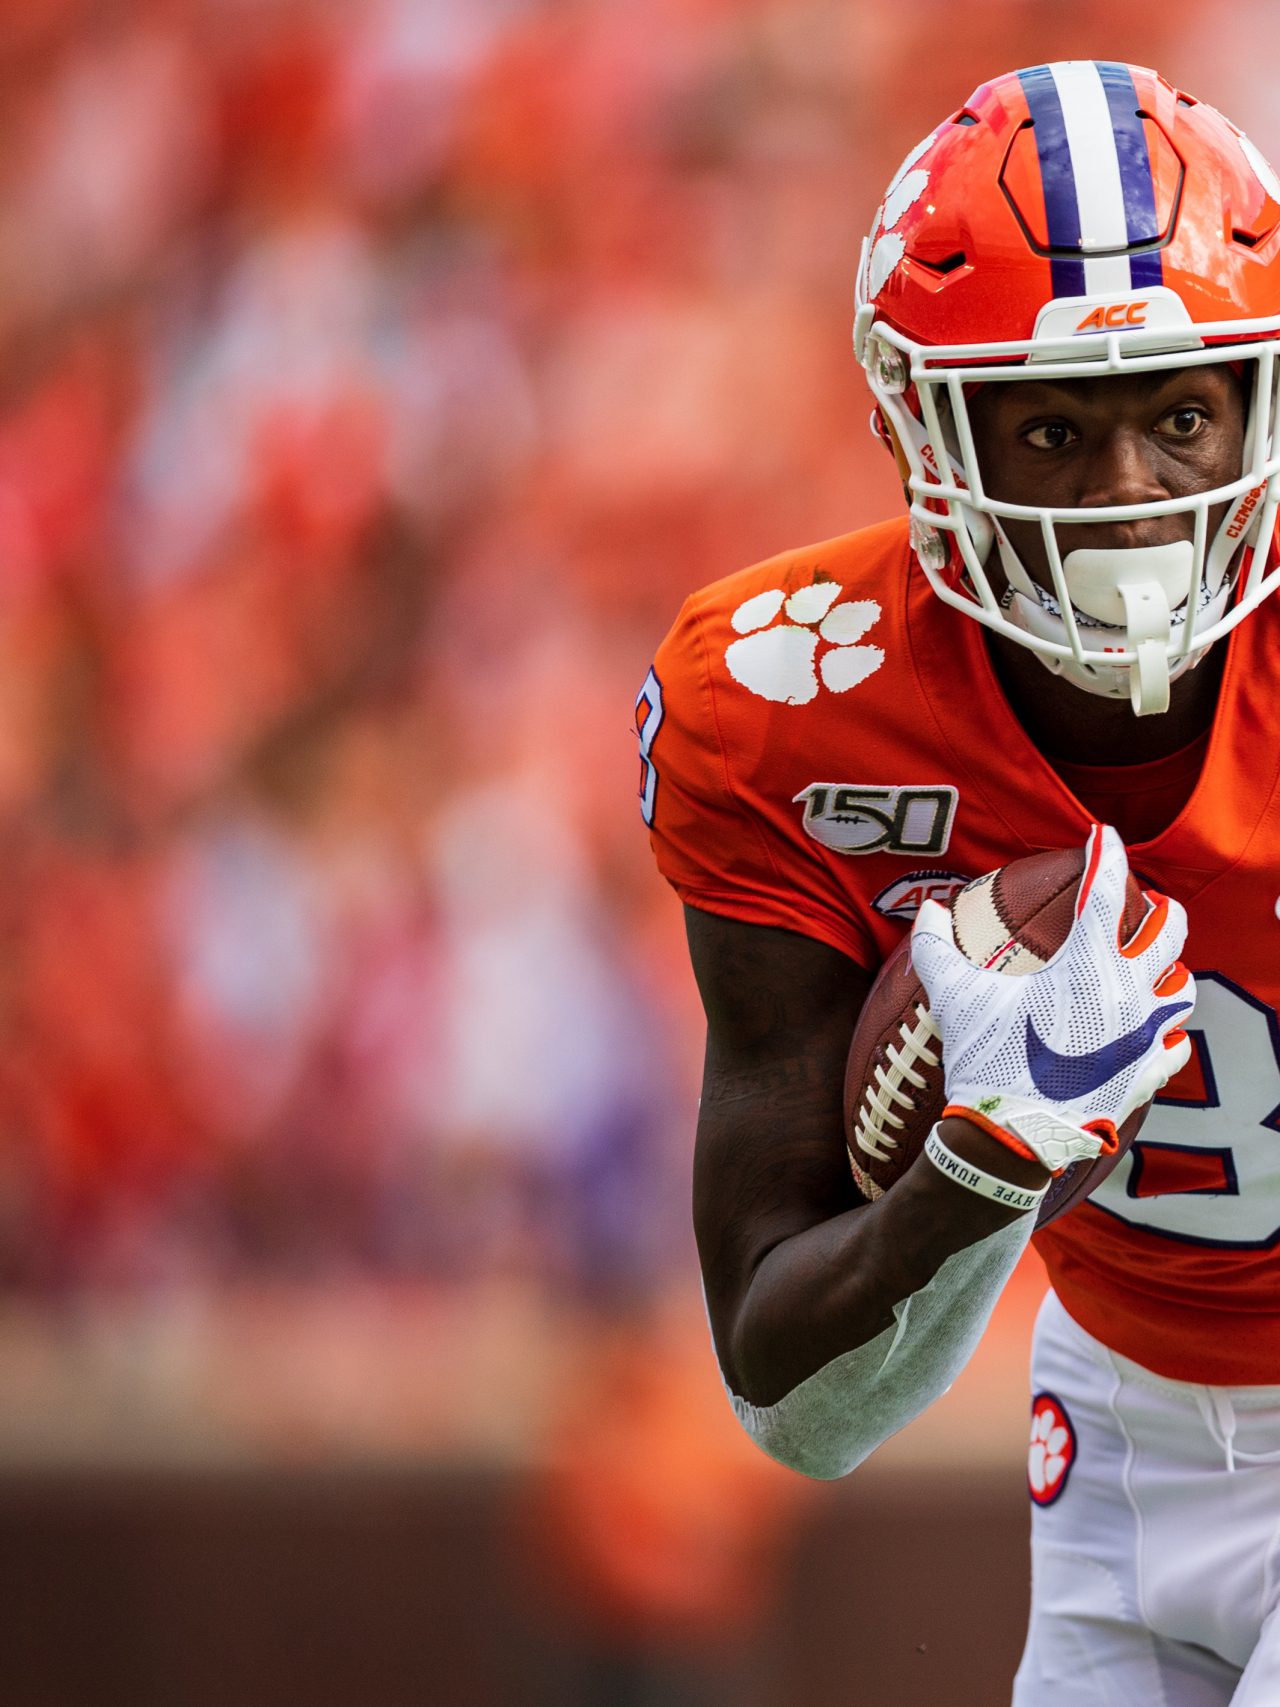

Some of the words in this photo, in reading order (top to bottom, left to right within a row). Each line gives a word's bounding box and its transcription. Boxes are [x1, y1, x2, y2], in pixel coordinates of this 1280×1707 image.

[1076, 301, 1149, 331] ACC
[635, 665, 666, 830] 8
[807, 788, 953, 852] 150
[928, 1141, 980, 1187] HUMBLE
[993, 1185, 1035, 1207] HYPE
